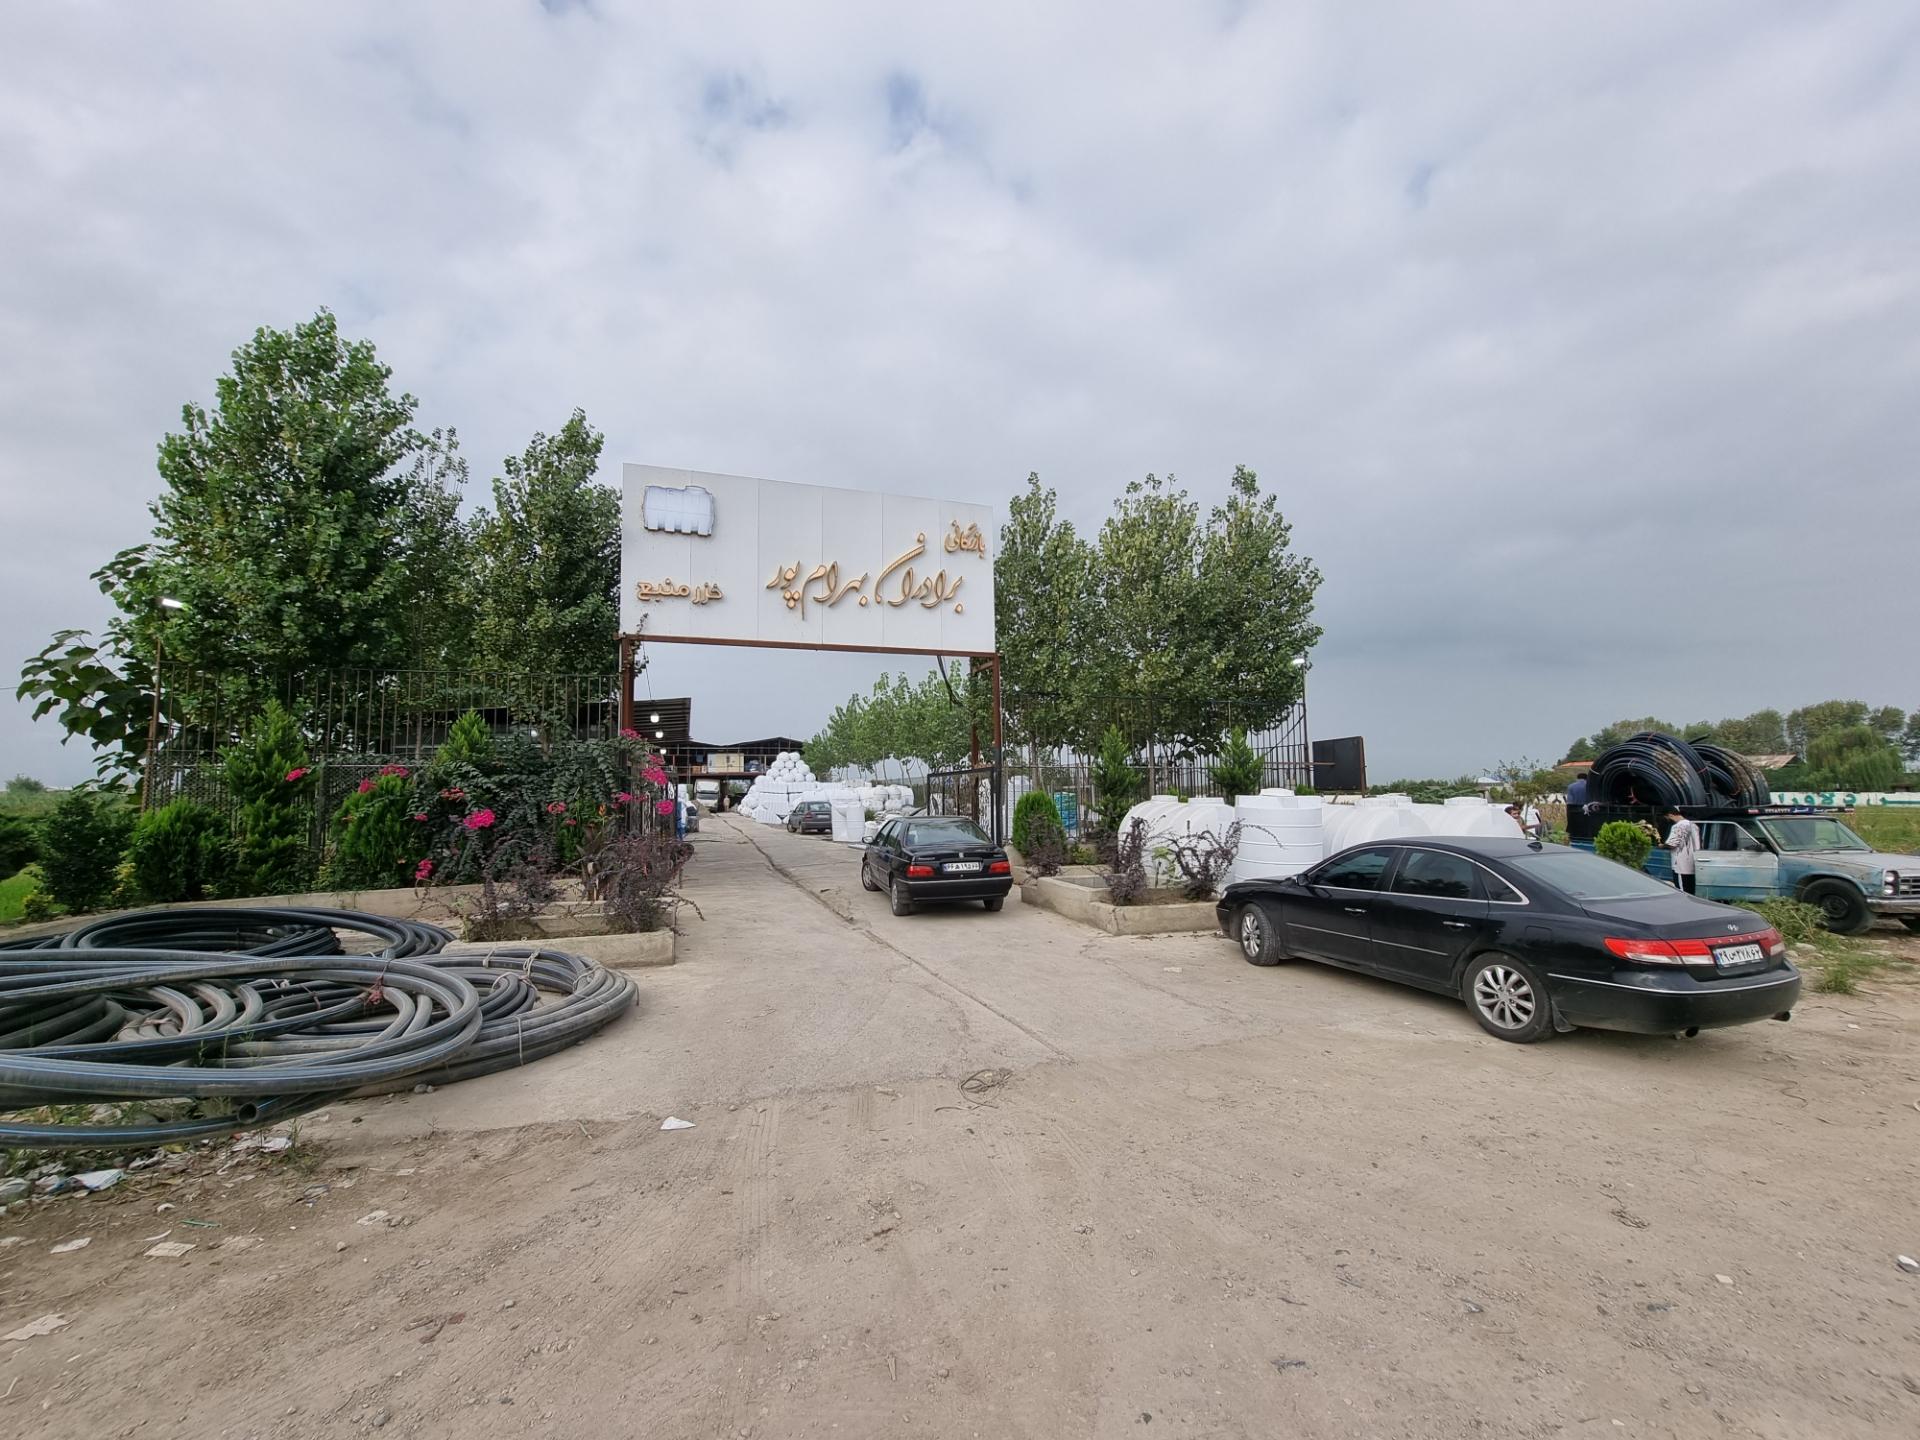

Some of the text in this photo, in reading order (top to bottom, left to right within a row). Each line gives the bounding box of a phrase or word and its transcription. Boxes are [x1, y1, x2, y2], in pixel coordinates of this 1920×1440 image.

[944, 520, 985, 559] بازرگانی
[637, 578, 723, 605] خزر منبع
[766, 533, 963, 620] برادران بهرام پور
